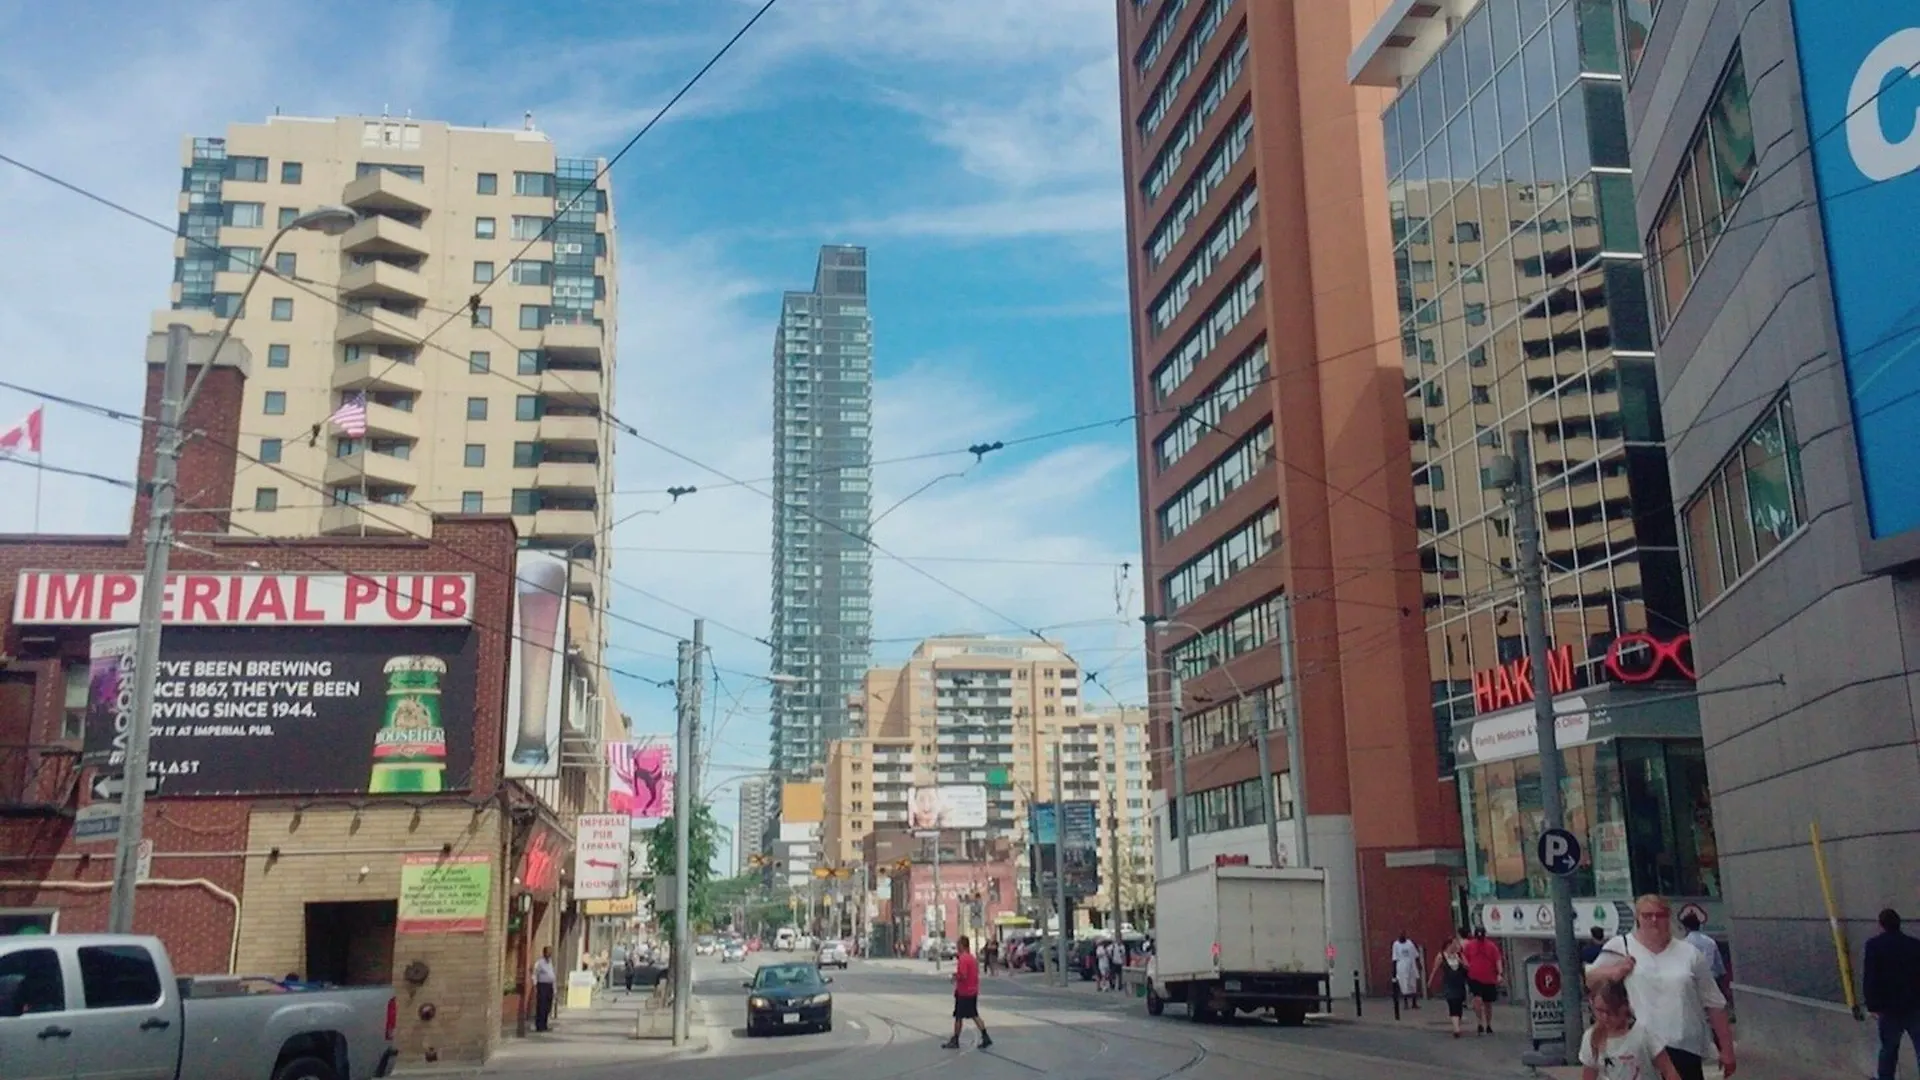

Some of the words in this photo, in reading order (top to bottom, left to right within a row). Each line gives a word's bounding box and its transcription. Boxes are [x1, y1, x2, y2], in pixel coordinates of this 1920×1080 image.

[23, 572, 325, 621] IMPERIAL
[344, 575, 467, 621] PUB
[156, 661, 191, 676] E'VE
[194, 661, 242, 676] BEEN
[247, 661, 332, 676] BREWING
[1475, 644, 1573, 713] HAKM
[154, 682, 185, 697] NCE
[189, 681, 228, 699] 1867,
[232, 681, 308, 697] THEY'VE
[313, 681, 360, 697] BEEN
[108, 651, 138, 766] GROOVE
[151, 702, 210, 718] RVING
[213, 702, 268, 718] SINCE
[271, 702, 317, 718] 1944.
[177, 726, 193, 736] AT
[194, 725, 245, 736] IMPERIAL
[580, 817, 626, 827] IMPERIAL
[593, 830, 613, 839] PUB
[582, 842, 623, 851] LIBRARY
[1545, 834, 1568, 866] P
